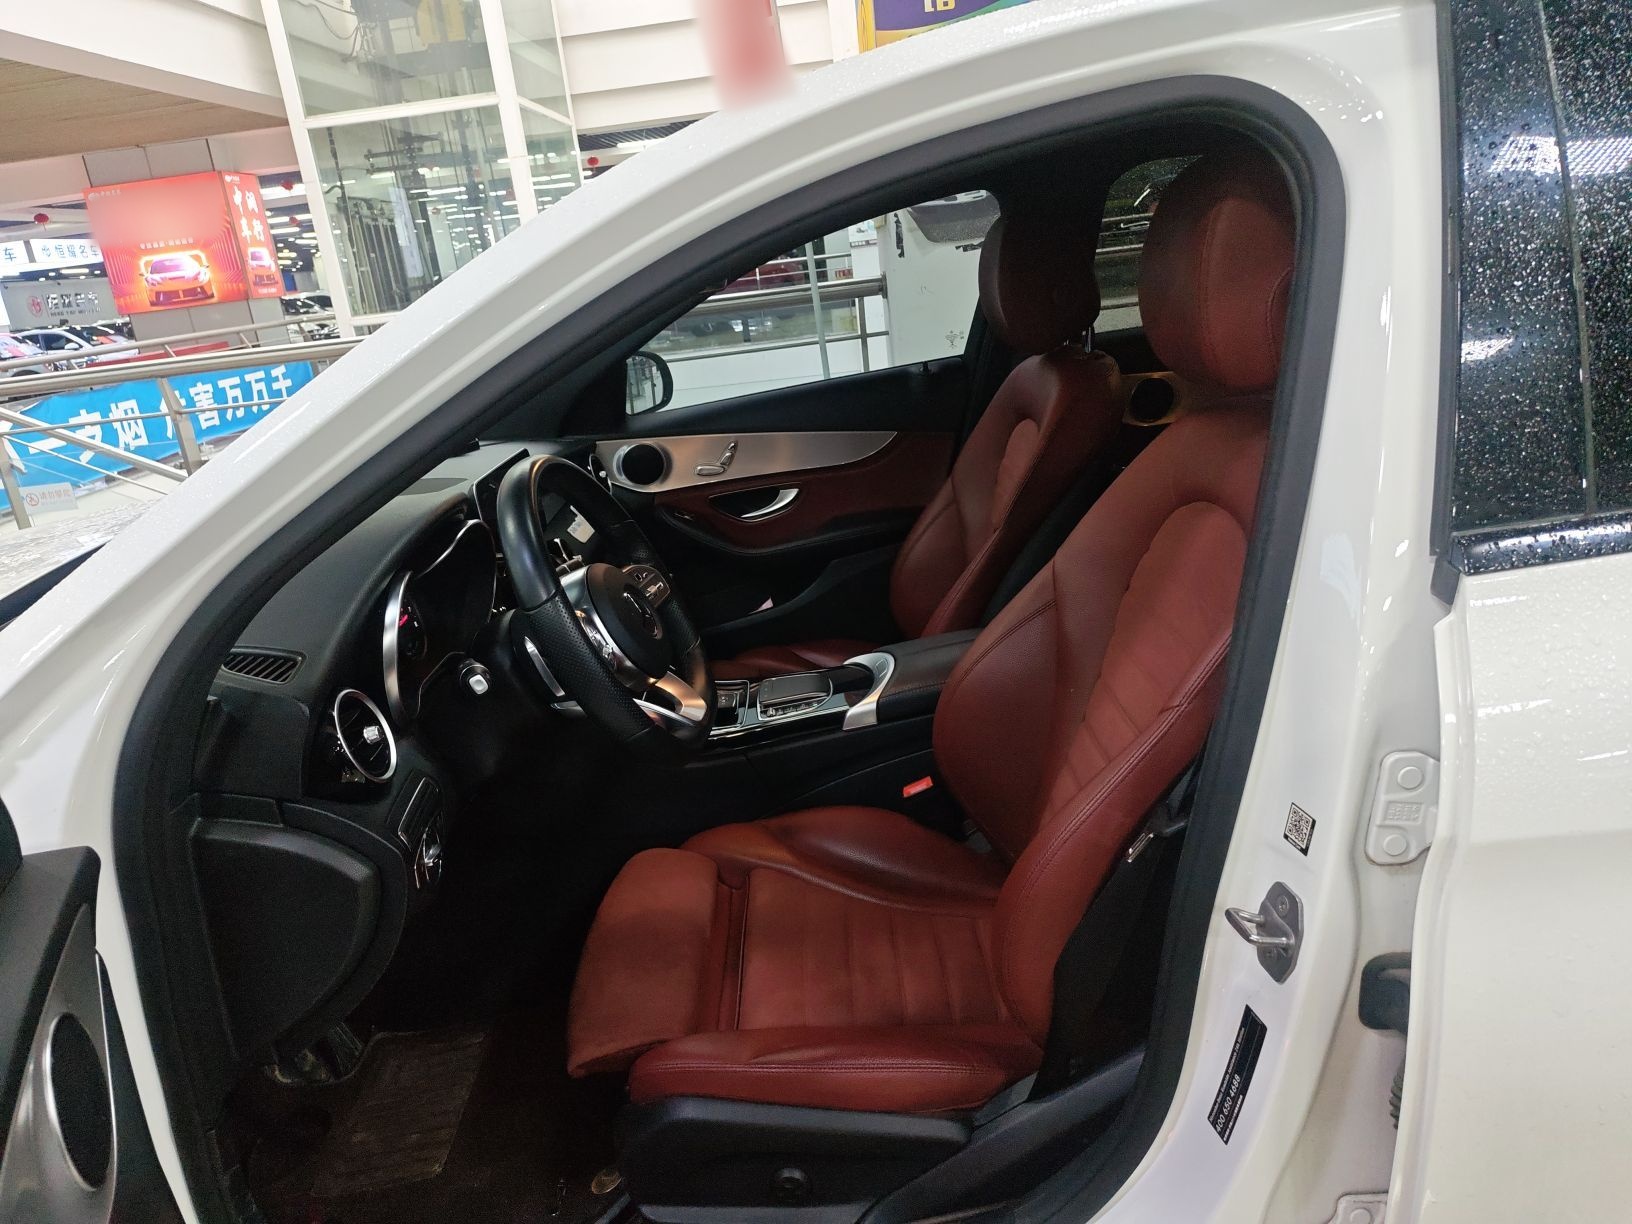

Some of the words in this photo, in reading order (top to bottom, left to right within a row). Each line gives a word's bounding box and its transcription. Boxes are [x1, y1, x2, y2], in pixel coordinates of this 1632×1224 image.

[1215, 1114, 1226, 1132] 400
[1222, 1096, 1232, 1115] 650
[1229, 1073, 1240, 1097] 4688
